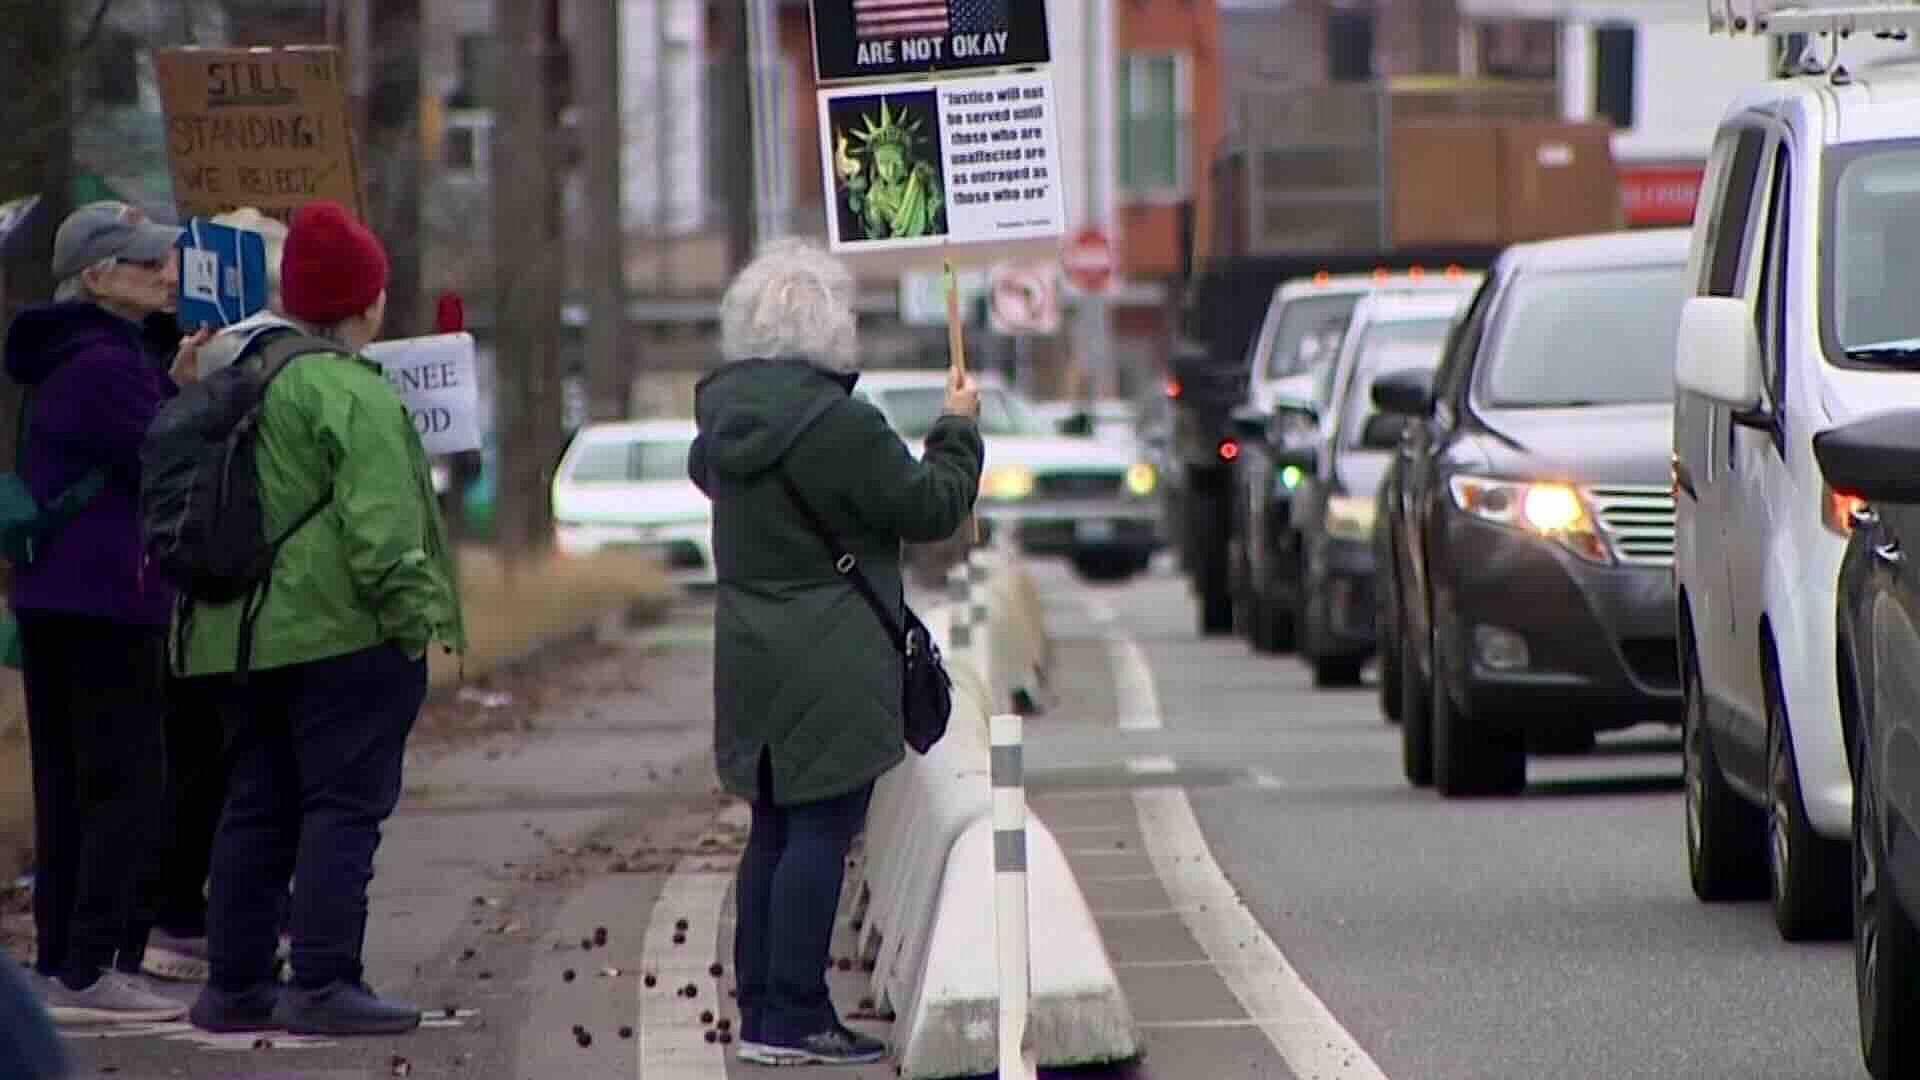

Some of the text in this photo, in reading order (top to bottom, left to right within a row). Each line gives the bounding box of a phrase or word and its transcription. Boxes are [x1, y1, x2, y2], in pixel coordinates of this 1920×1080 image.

[857, 31, 1008, 65] ARE NOT OKAY
[207, 62, 299, 98] STILL
[997, 86, 1020, 101] will
[1023, 85, 1044, 100] not
[947, 104, 1043, 125] be served until
[951, 128, 1042, 145] those who are
[951, 147, 1046, 165] unaffected are
[182, 166, 222, 193] WE
[952, 166, 1049, 185] as outraged as
[953, 191, 990, 206] those
[993, 188, 1020, 202] who
